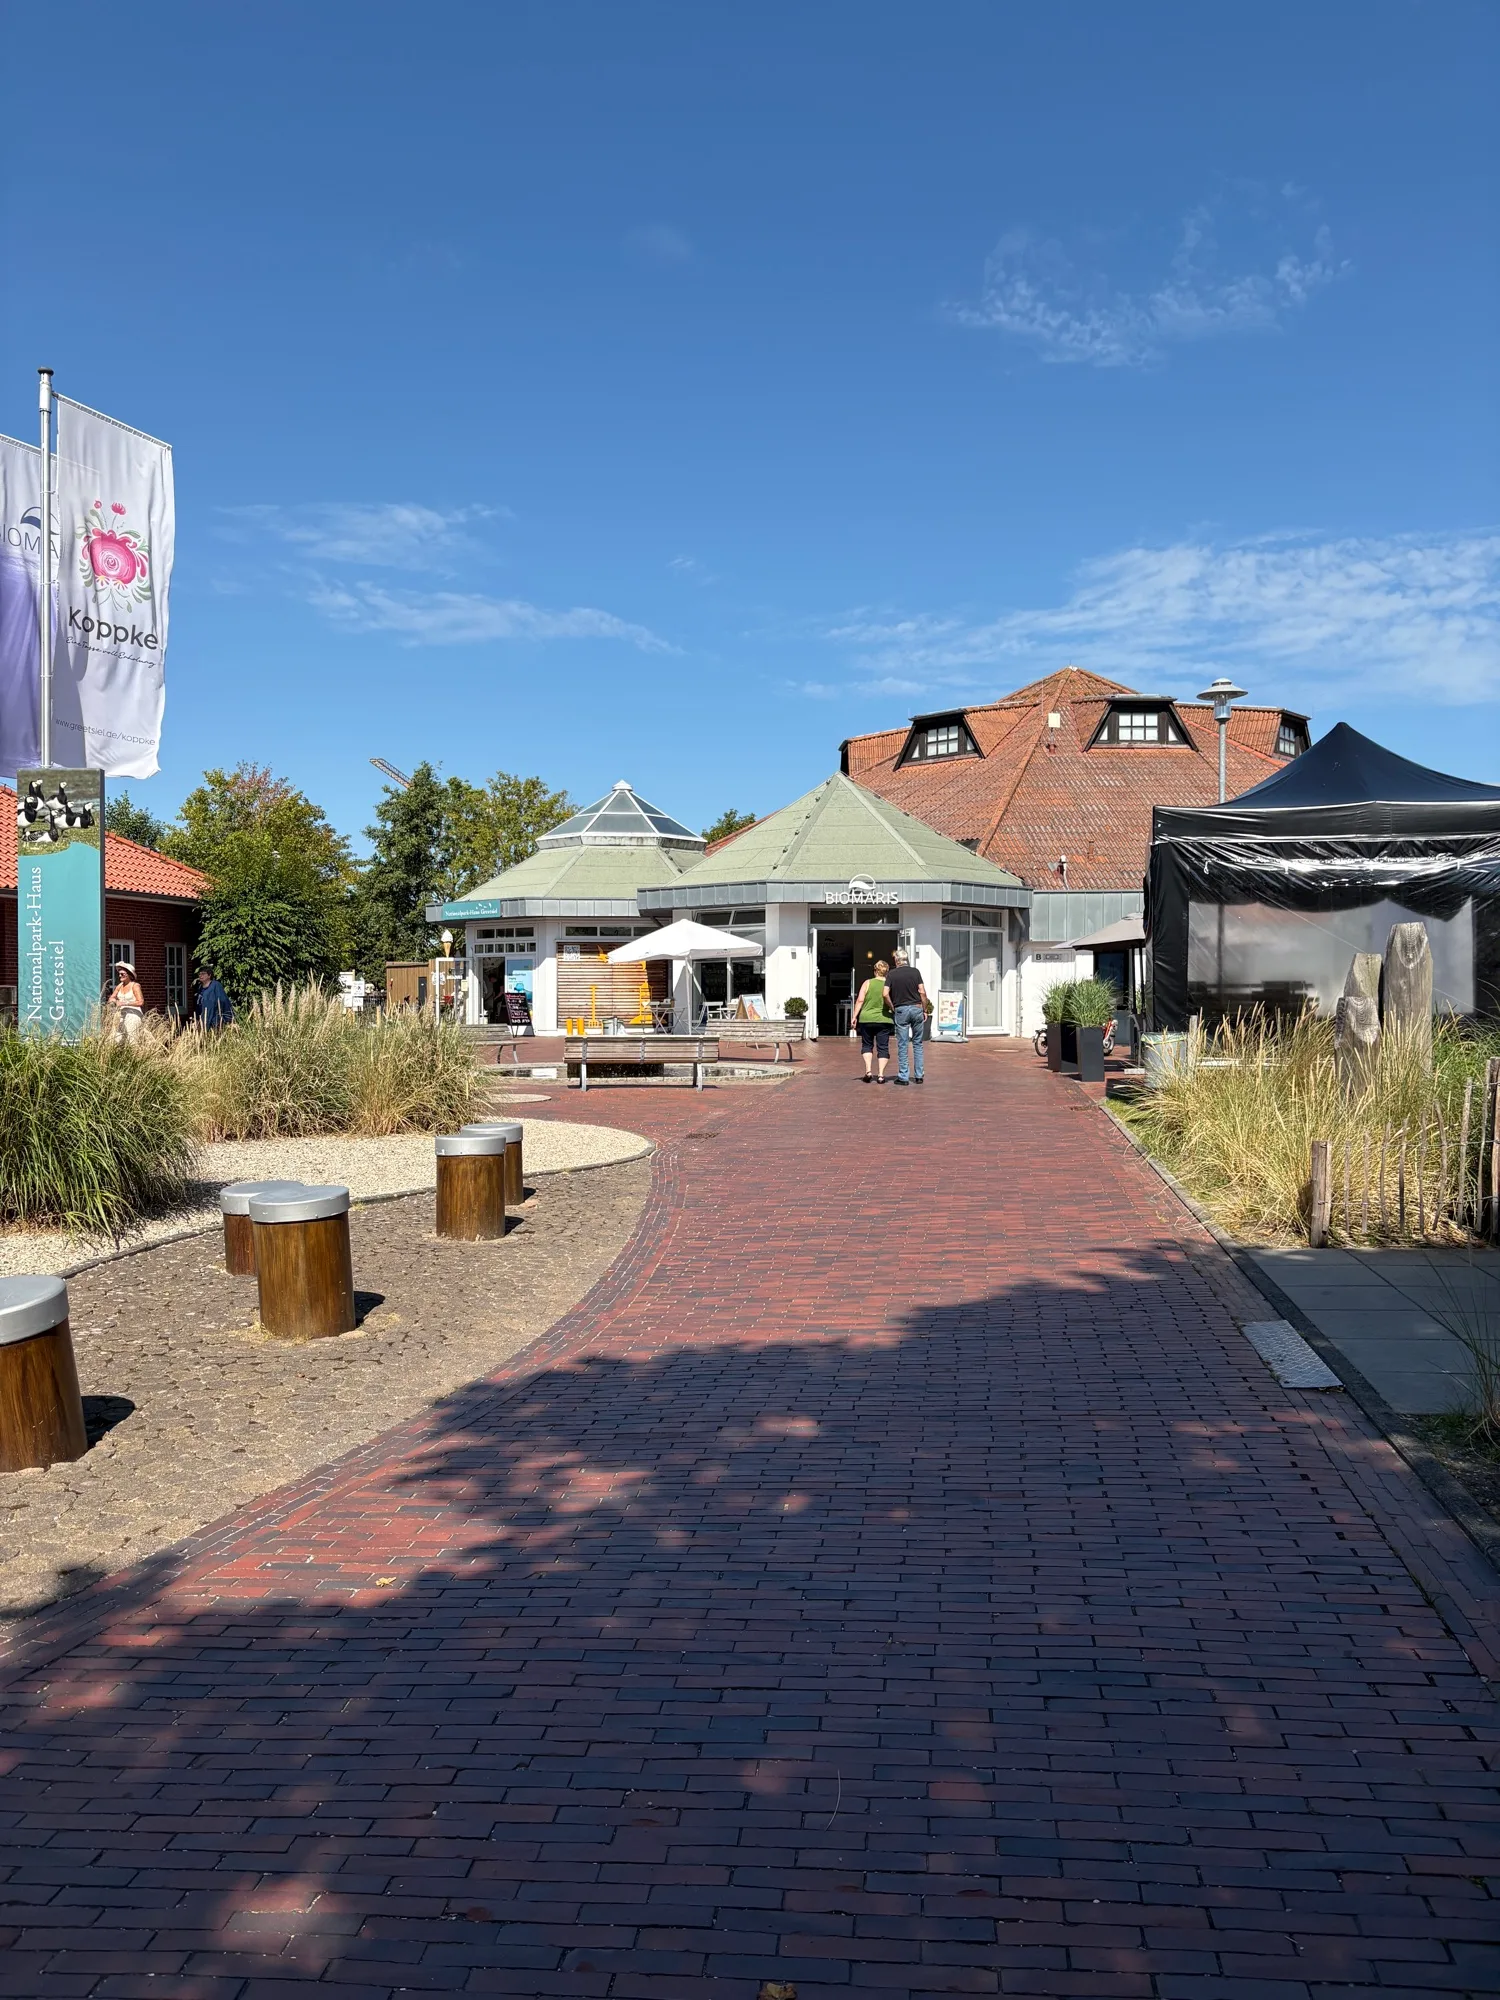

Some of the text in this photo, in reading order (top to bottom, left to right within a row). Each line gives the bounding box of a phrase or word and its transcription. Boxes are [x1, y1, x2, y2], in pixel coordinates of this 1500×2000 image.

[68, 606, 159, 650] Koppke
[118, 652, 156, 668] Erholung
[55, 718, 156, 746] www.greetsiel.de/koppke
[825, 891, 899, 905] BIOMARIS
[26, 866, 46, 1021] Nationalpark-Haus
[48, 939, 65, 1021] Greetsiel
